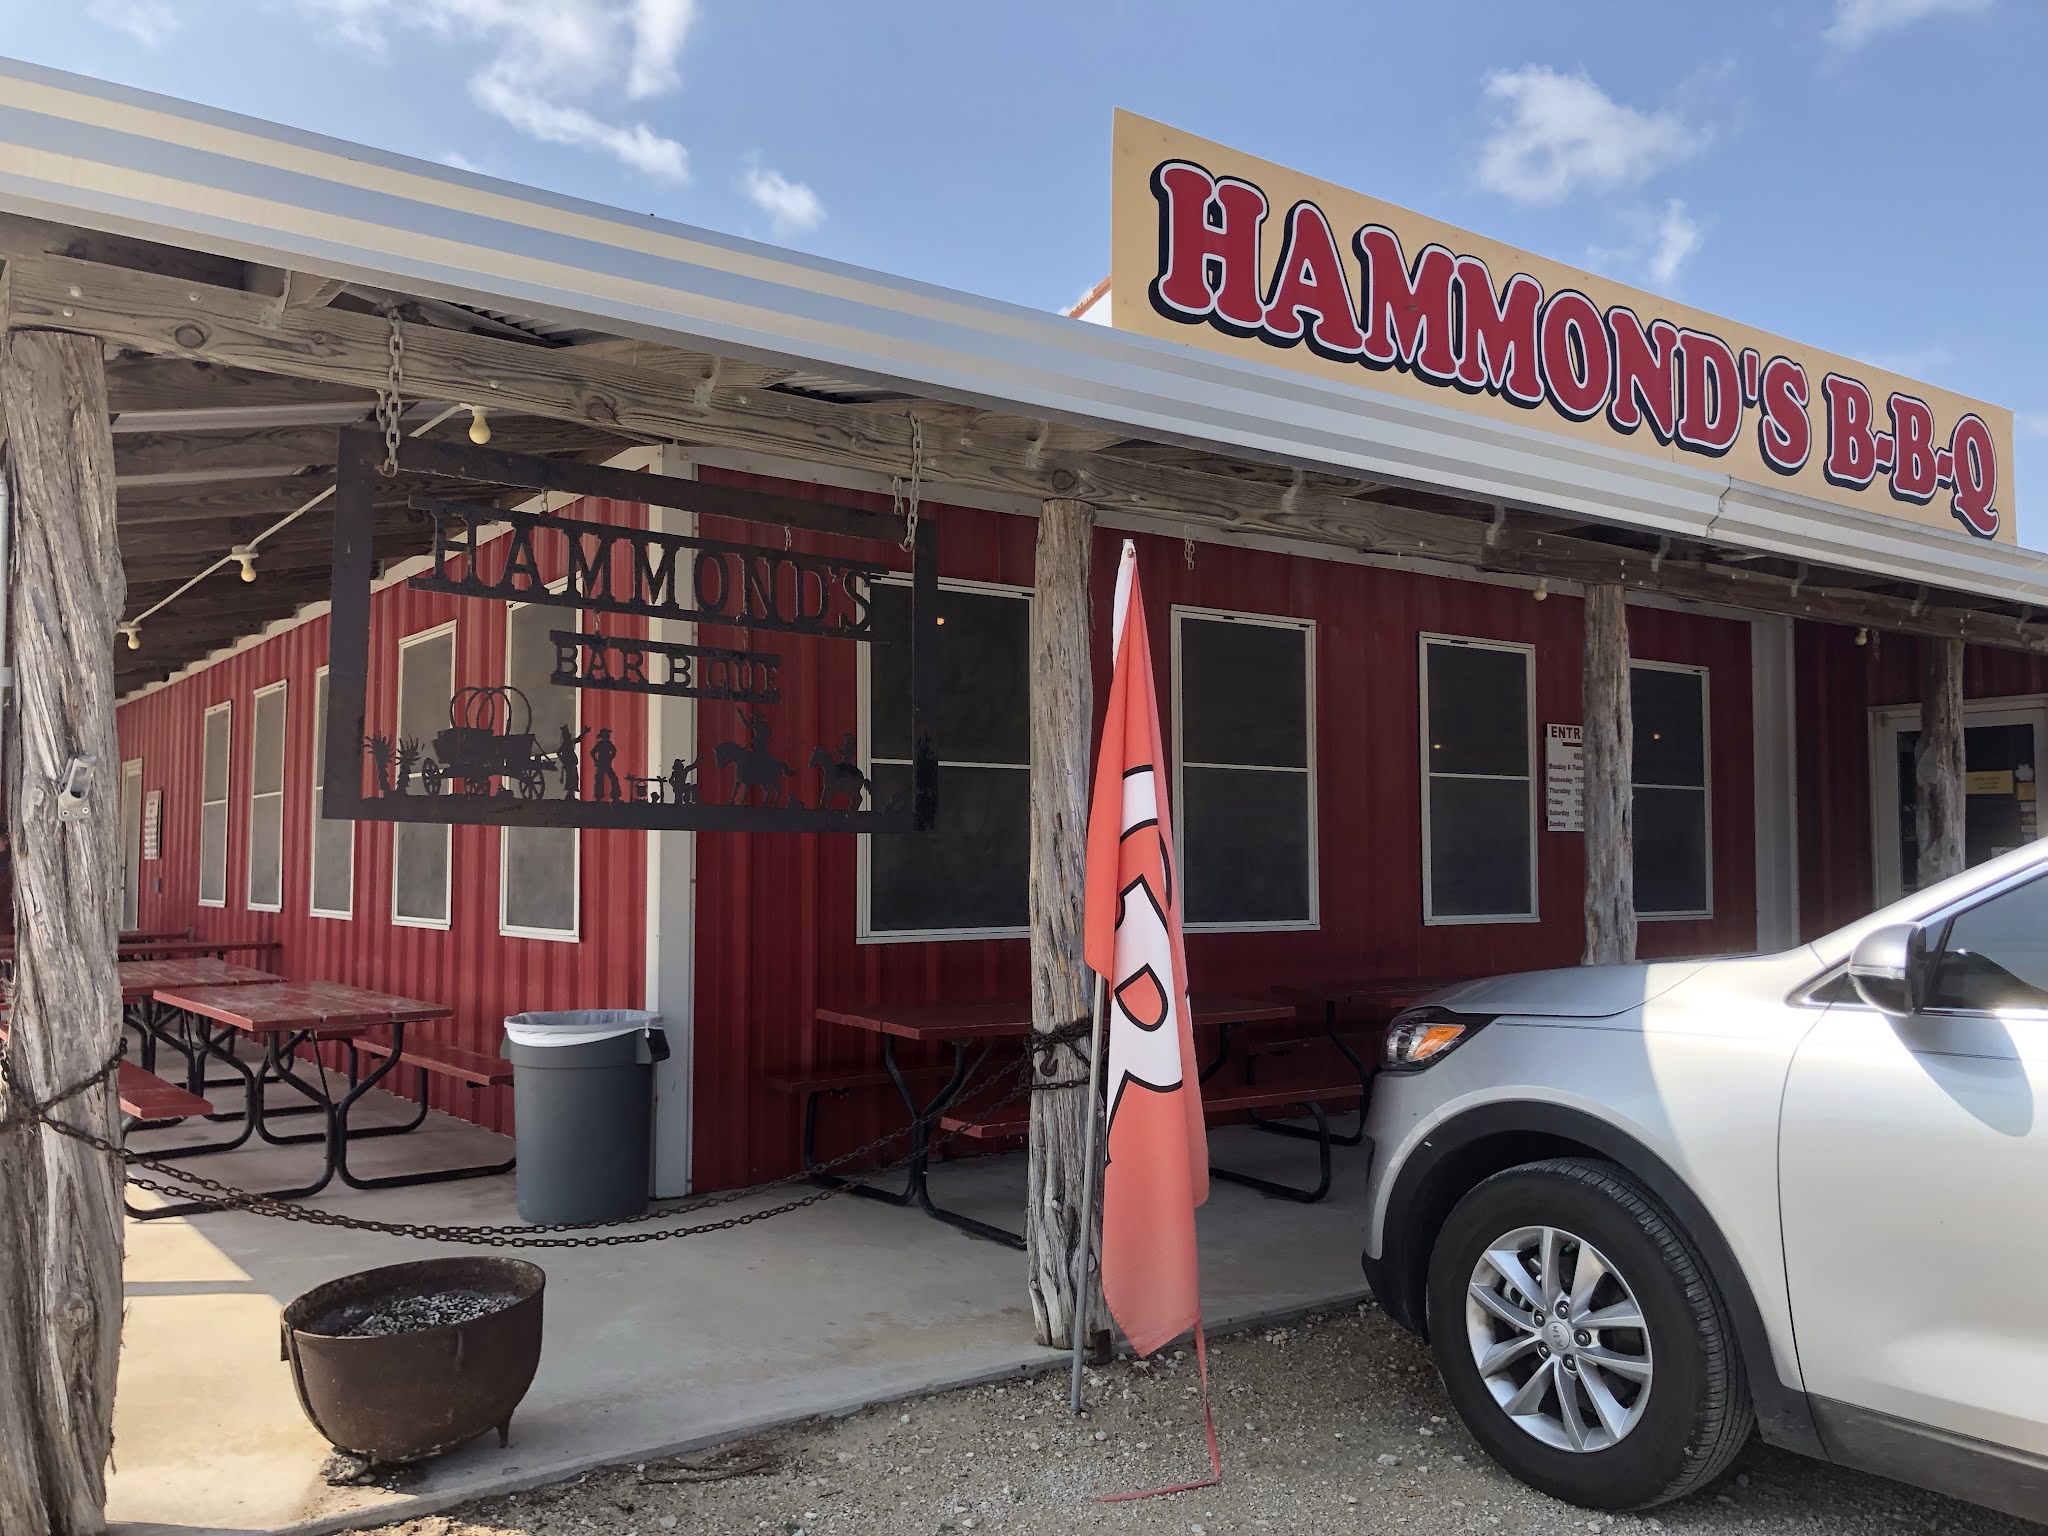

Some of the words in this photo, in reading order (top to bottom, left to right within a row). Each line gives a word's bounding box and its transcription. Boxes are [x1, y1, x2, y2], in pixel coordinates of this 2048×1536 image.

[1149, 158, 1813, 476] HAMMOND'S
[1822, 372, 2000, 539] B-B-Q
[429, 500, 874, 634] HAMMOND'S
[551, 636, 651, 687] BAR
[1551, 726, 1583, 739] ENTR
